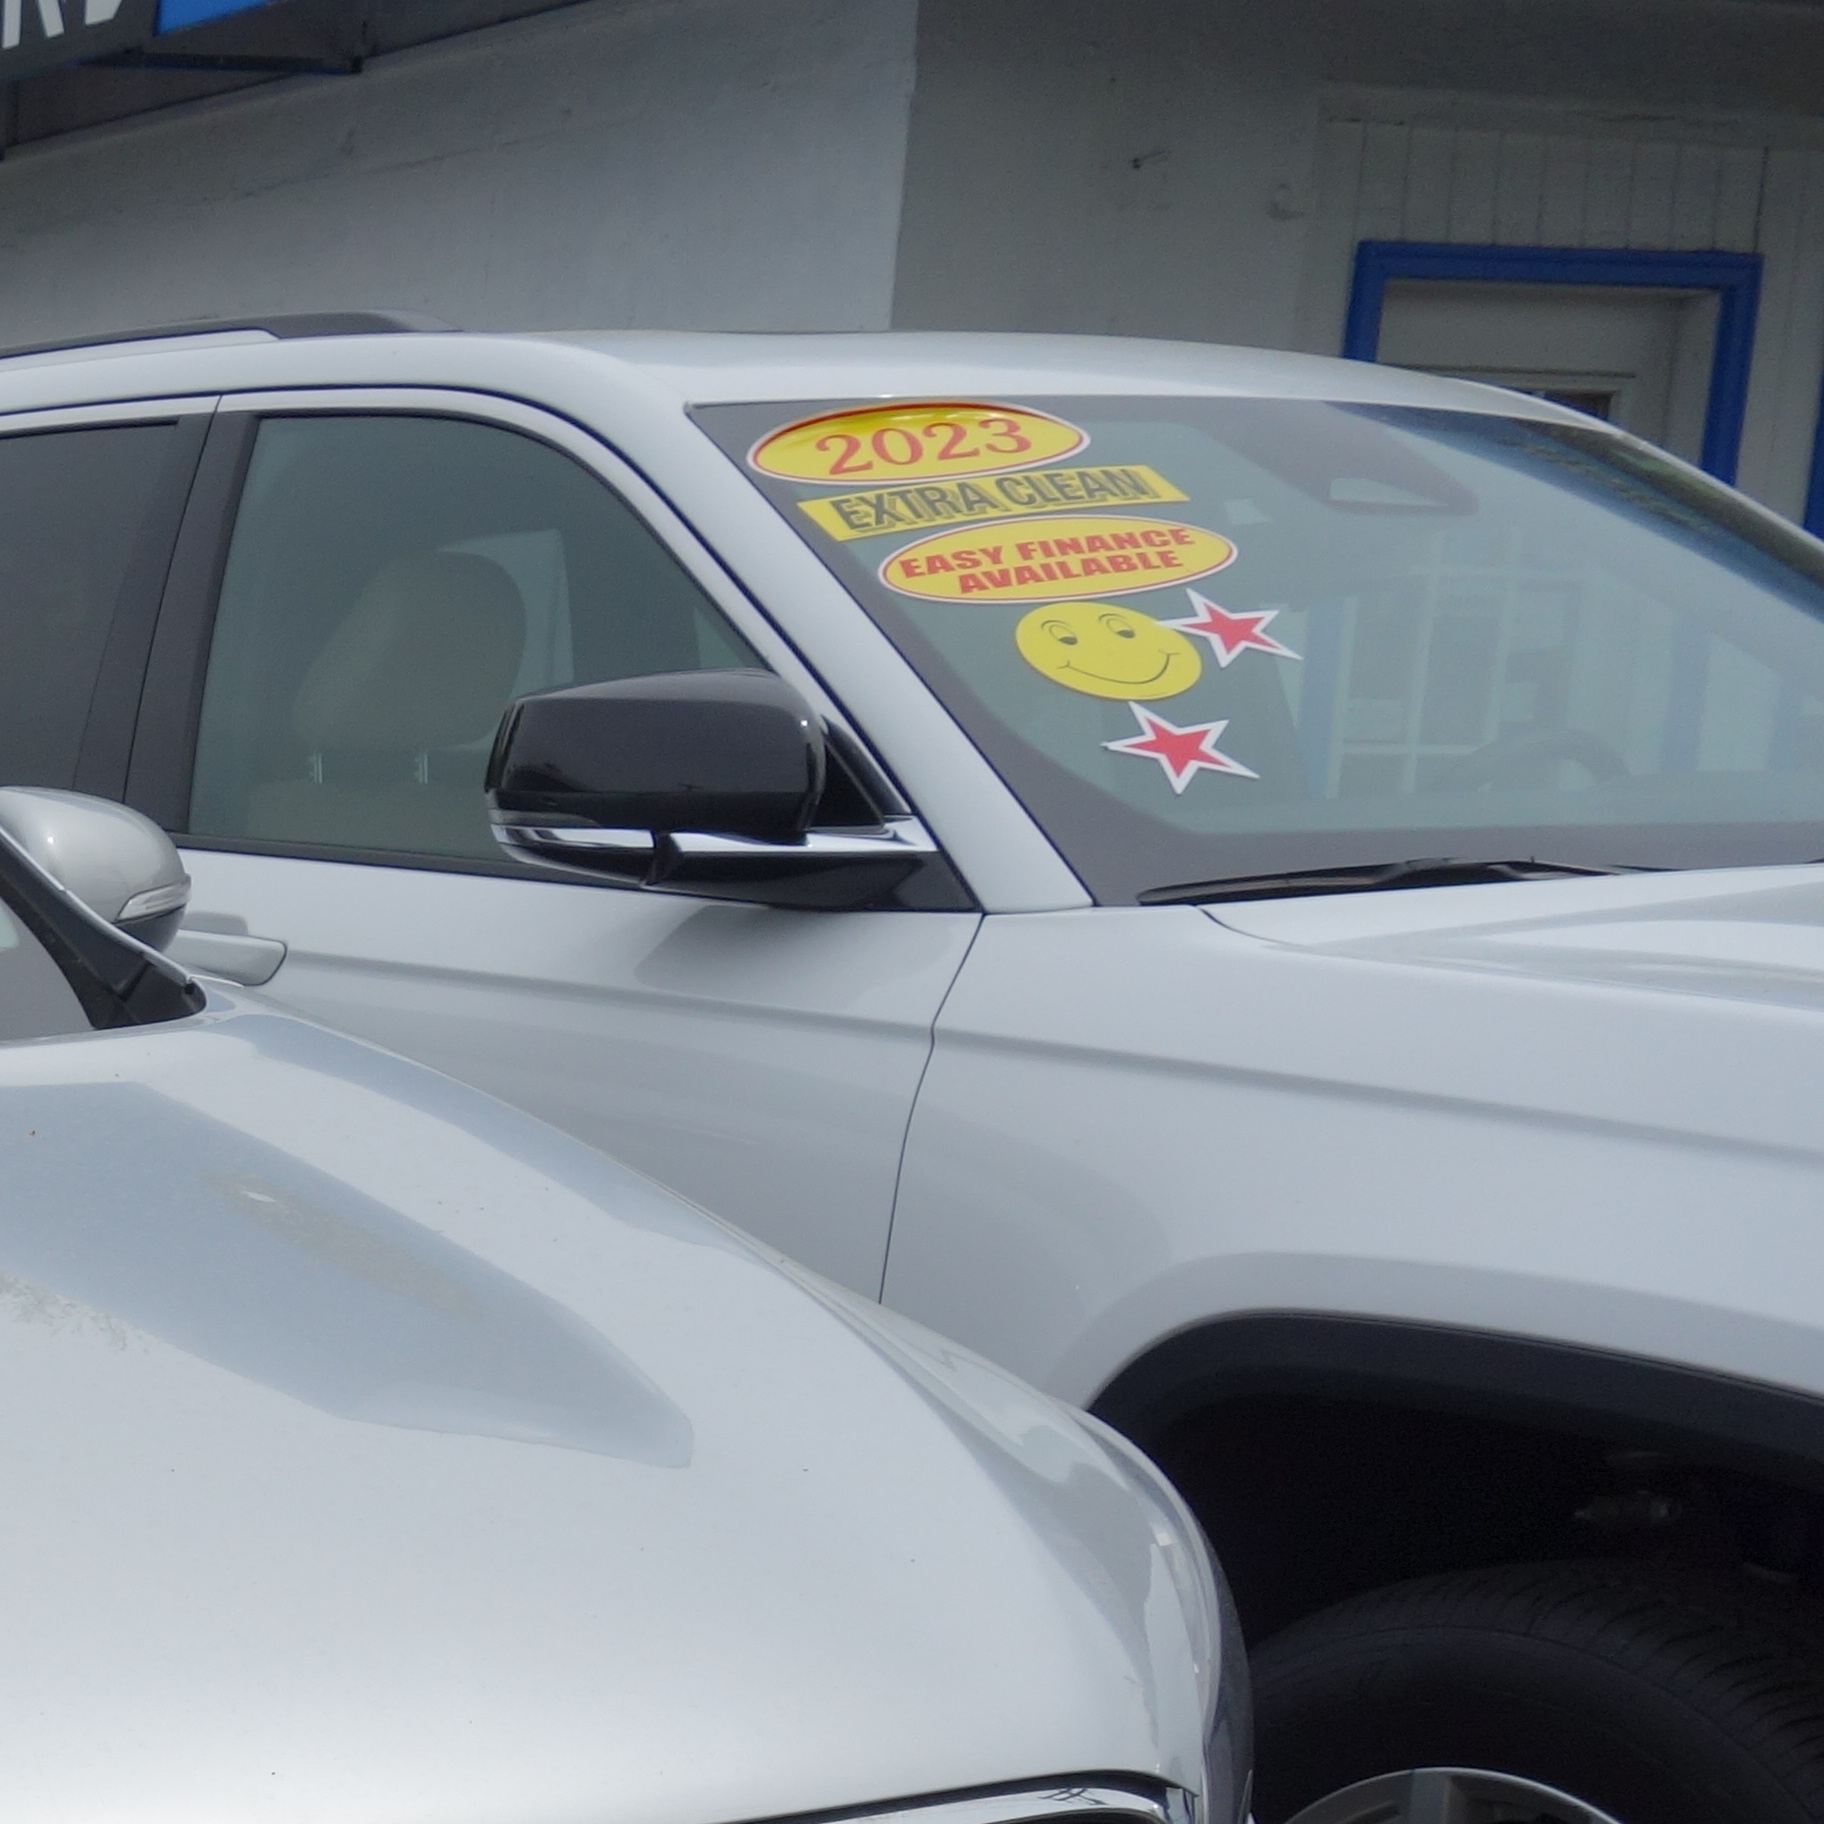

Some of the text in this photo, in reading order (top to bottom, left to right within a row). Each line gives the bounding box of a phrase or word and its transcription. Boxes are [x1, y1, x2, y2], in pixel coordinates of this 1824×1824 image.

[815, 418, 1032, 475] 2023
[829, 469, 1160, 532] EXTRA CLEAN
[899, 528, 1195, 578] EASY FINANCE
[958, 550, 1183, 594] AVAILABLE
